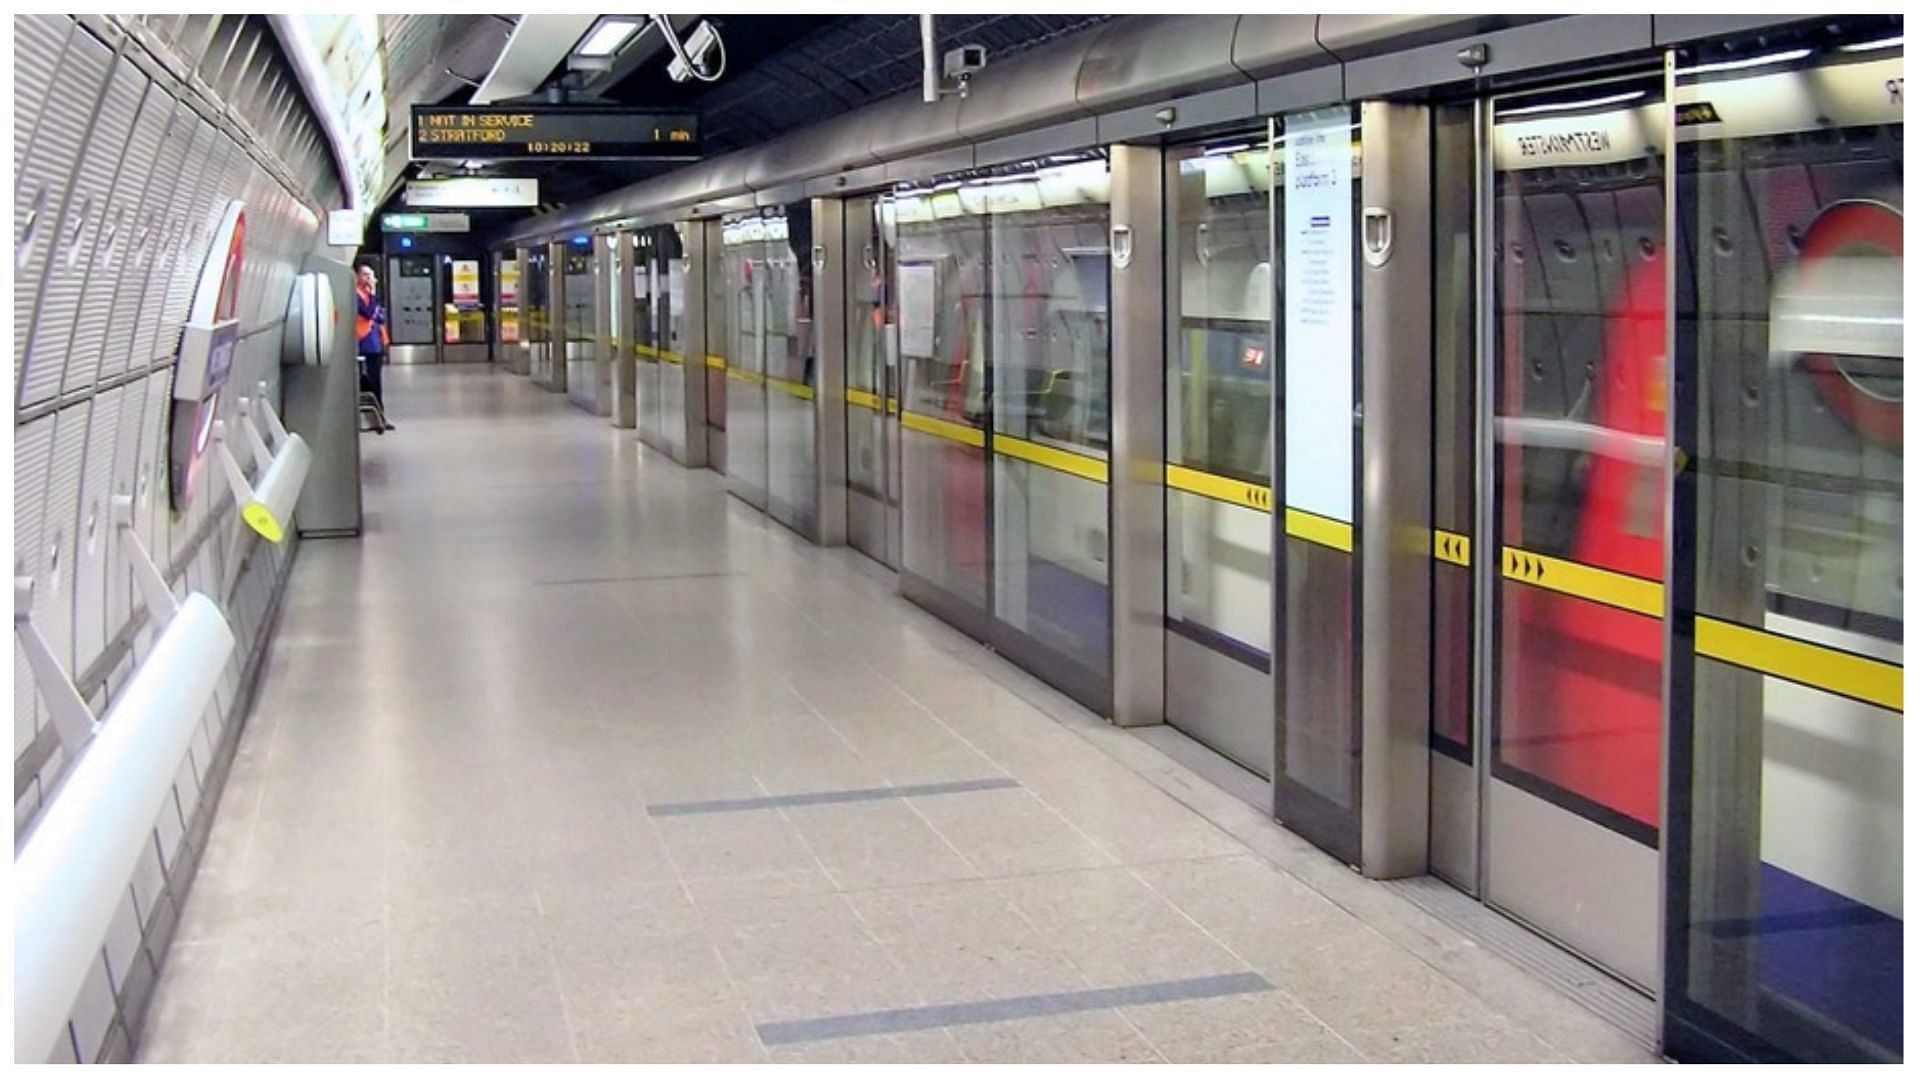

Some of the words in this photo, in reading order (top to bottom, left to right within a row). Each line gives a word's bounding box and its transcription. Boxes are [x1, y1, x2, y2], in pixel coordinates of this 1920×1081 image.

[417, 114, 424, 127] 1
[430, 114, 457, 127] NOT
[462, 114, 475, 127] IN
[479, 114, 534, 127] SERVICE
[418, 129, 428, 142] 2
[431, 129, 505, 142] STRATFORD
[654, 128, 660, 141] 1
[670, 130, 690, 141] min
[528, 141, 590, 153] 10:20:22
